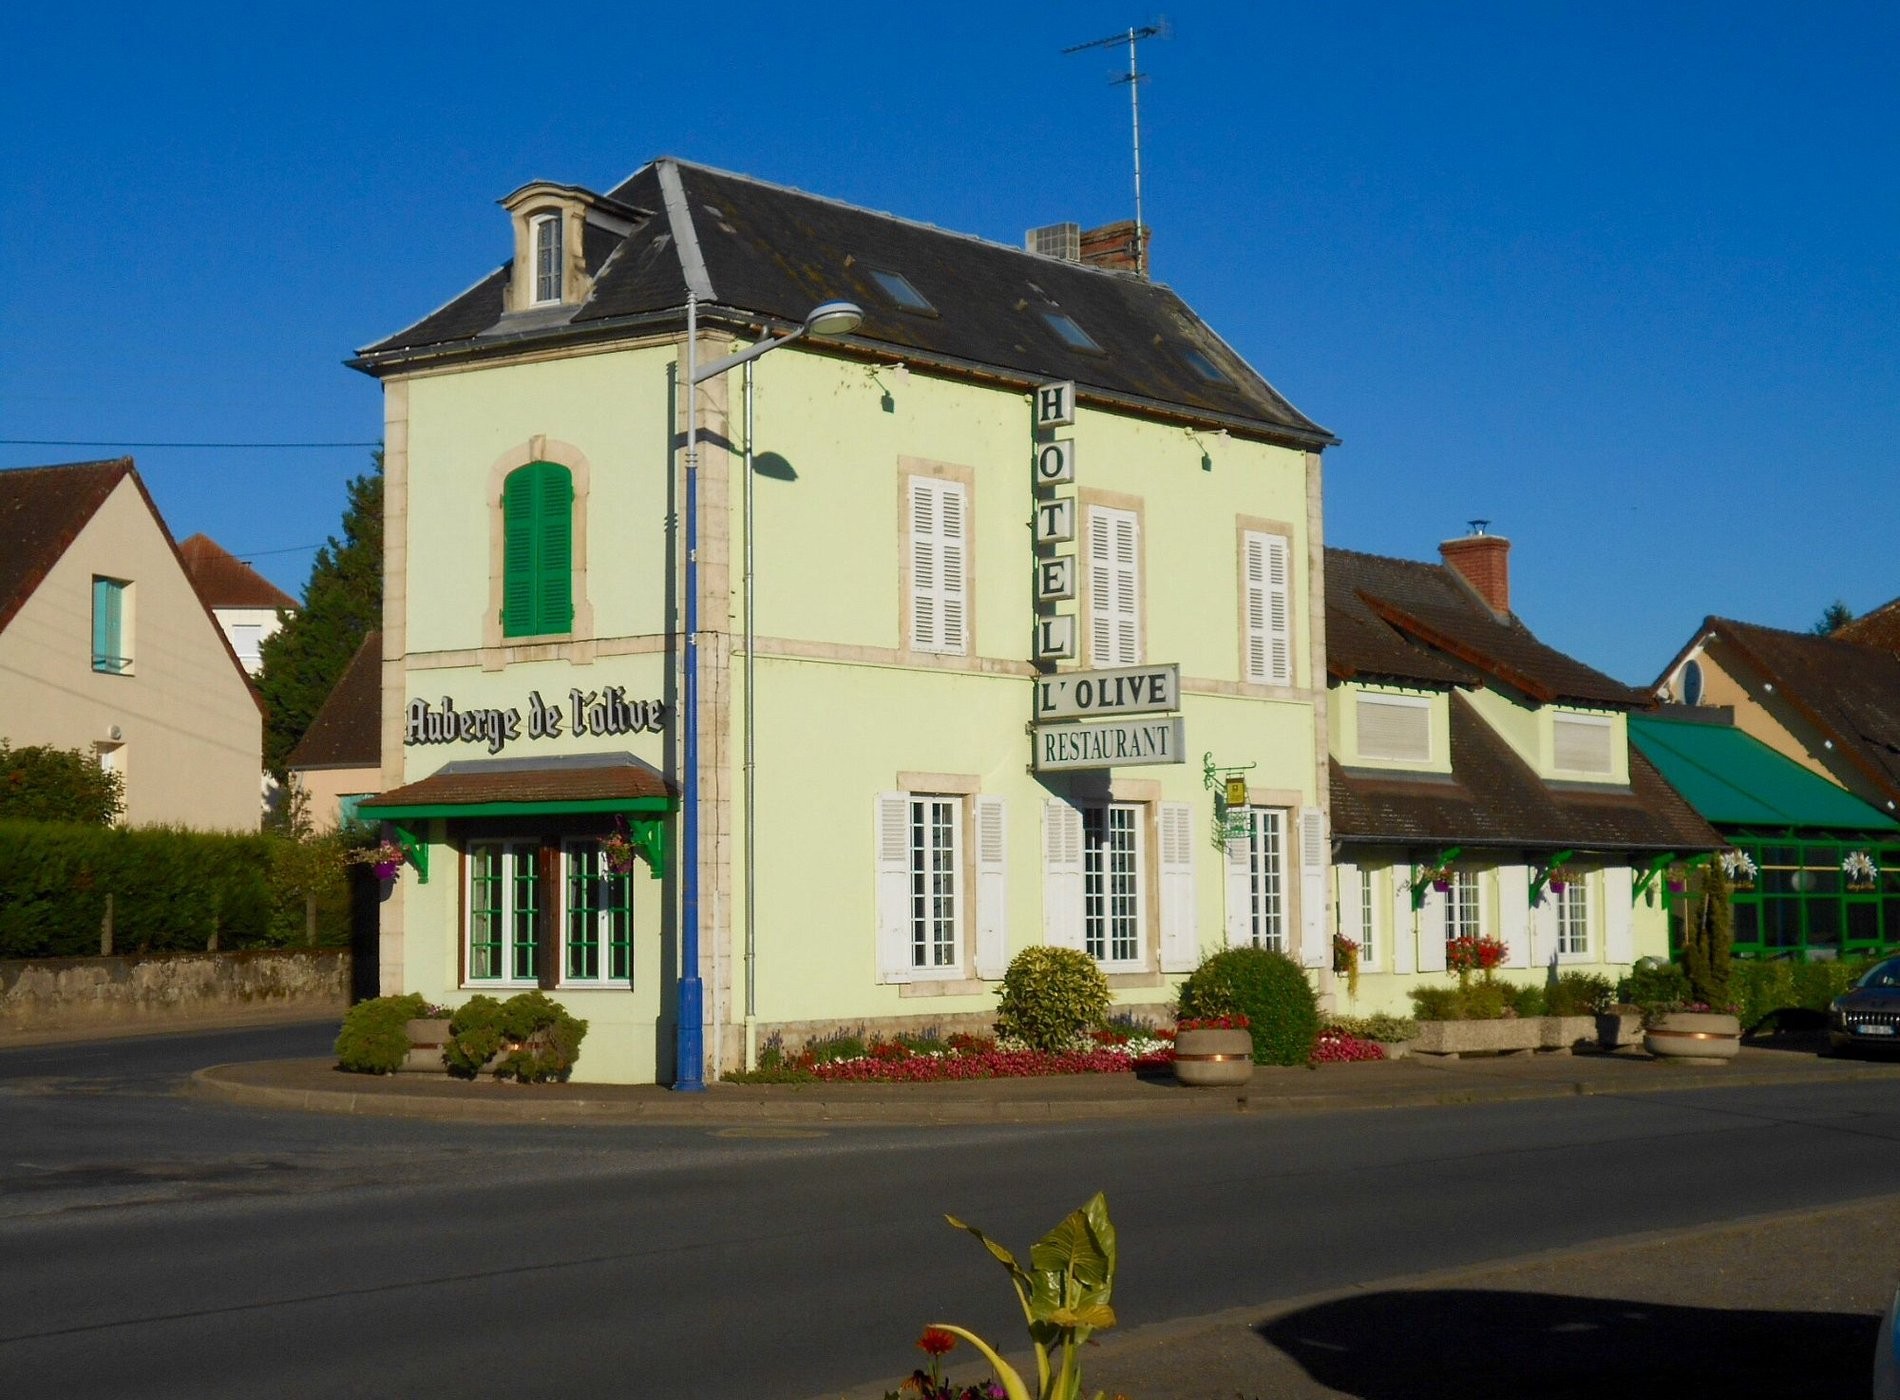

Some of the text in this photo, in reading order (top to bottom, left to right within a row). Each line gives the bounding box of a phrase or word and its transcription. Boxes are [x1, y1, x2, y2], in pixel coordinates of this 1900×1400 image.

[1039, 387, 1065, 654] HOTEL
[404, 685, 667, 755] Auberge de l'olive
[1044, 725, 1170, 763] RESTAURANT
